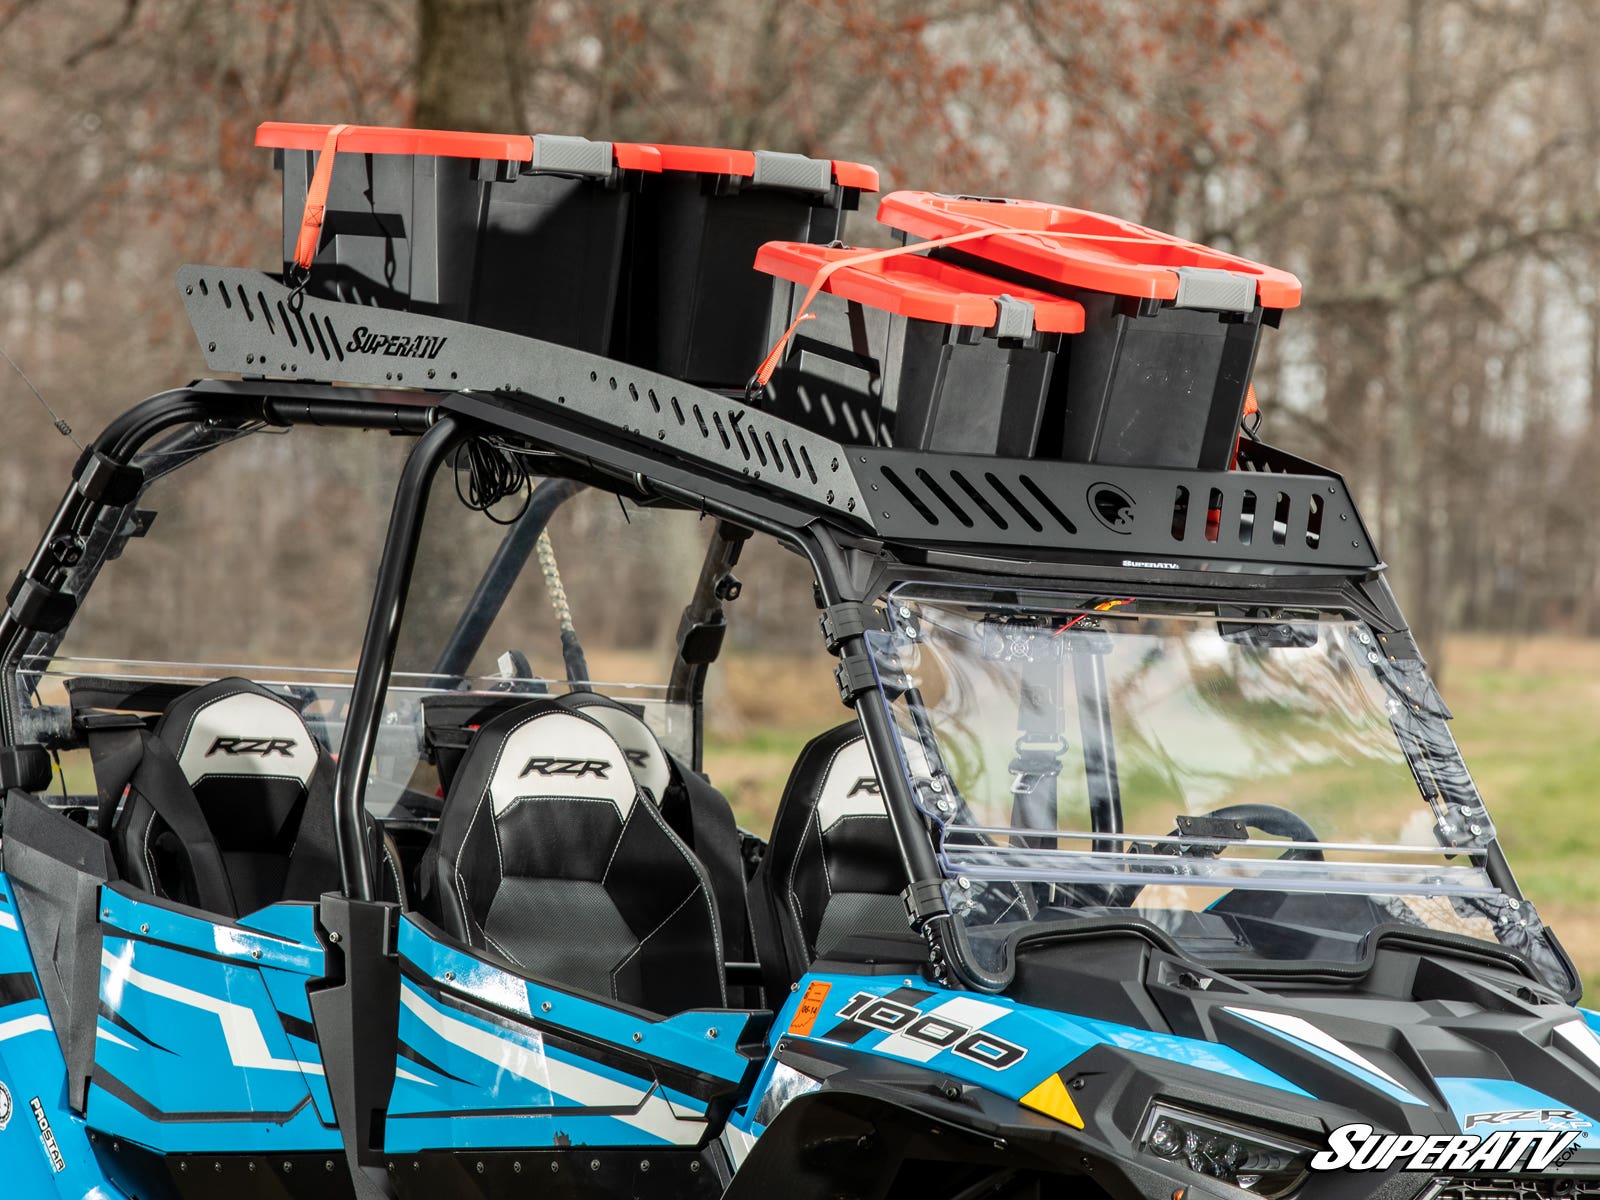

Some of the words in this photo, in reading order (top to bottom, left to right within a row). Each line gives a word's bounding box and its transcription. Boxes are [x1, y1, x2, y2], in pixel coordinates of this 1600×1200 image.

[204, 736, 297, 758] RZR
[518, 756, 613, 780] RZR
[835, 991, 1029, 1071] 1000
[1464, 1109, 1584, 1132] RZR
[29, 1097, 65, 1172] PROSTAR
